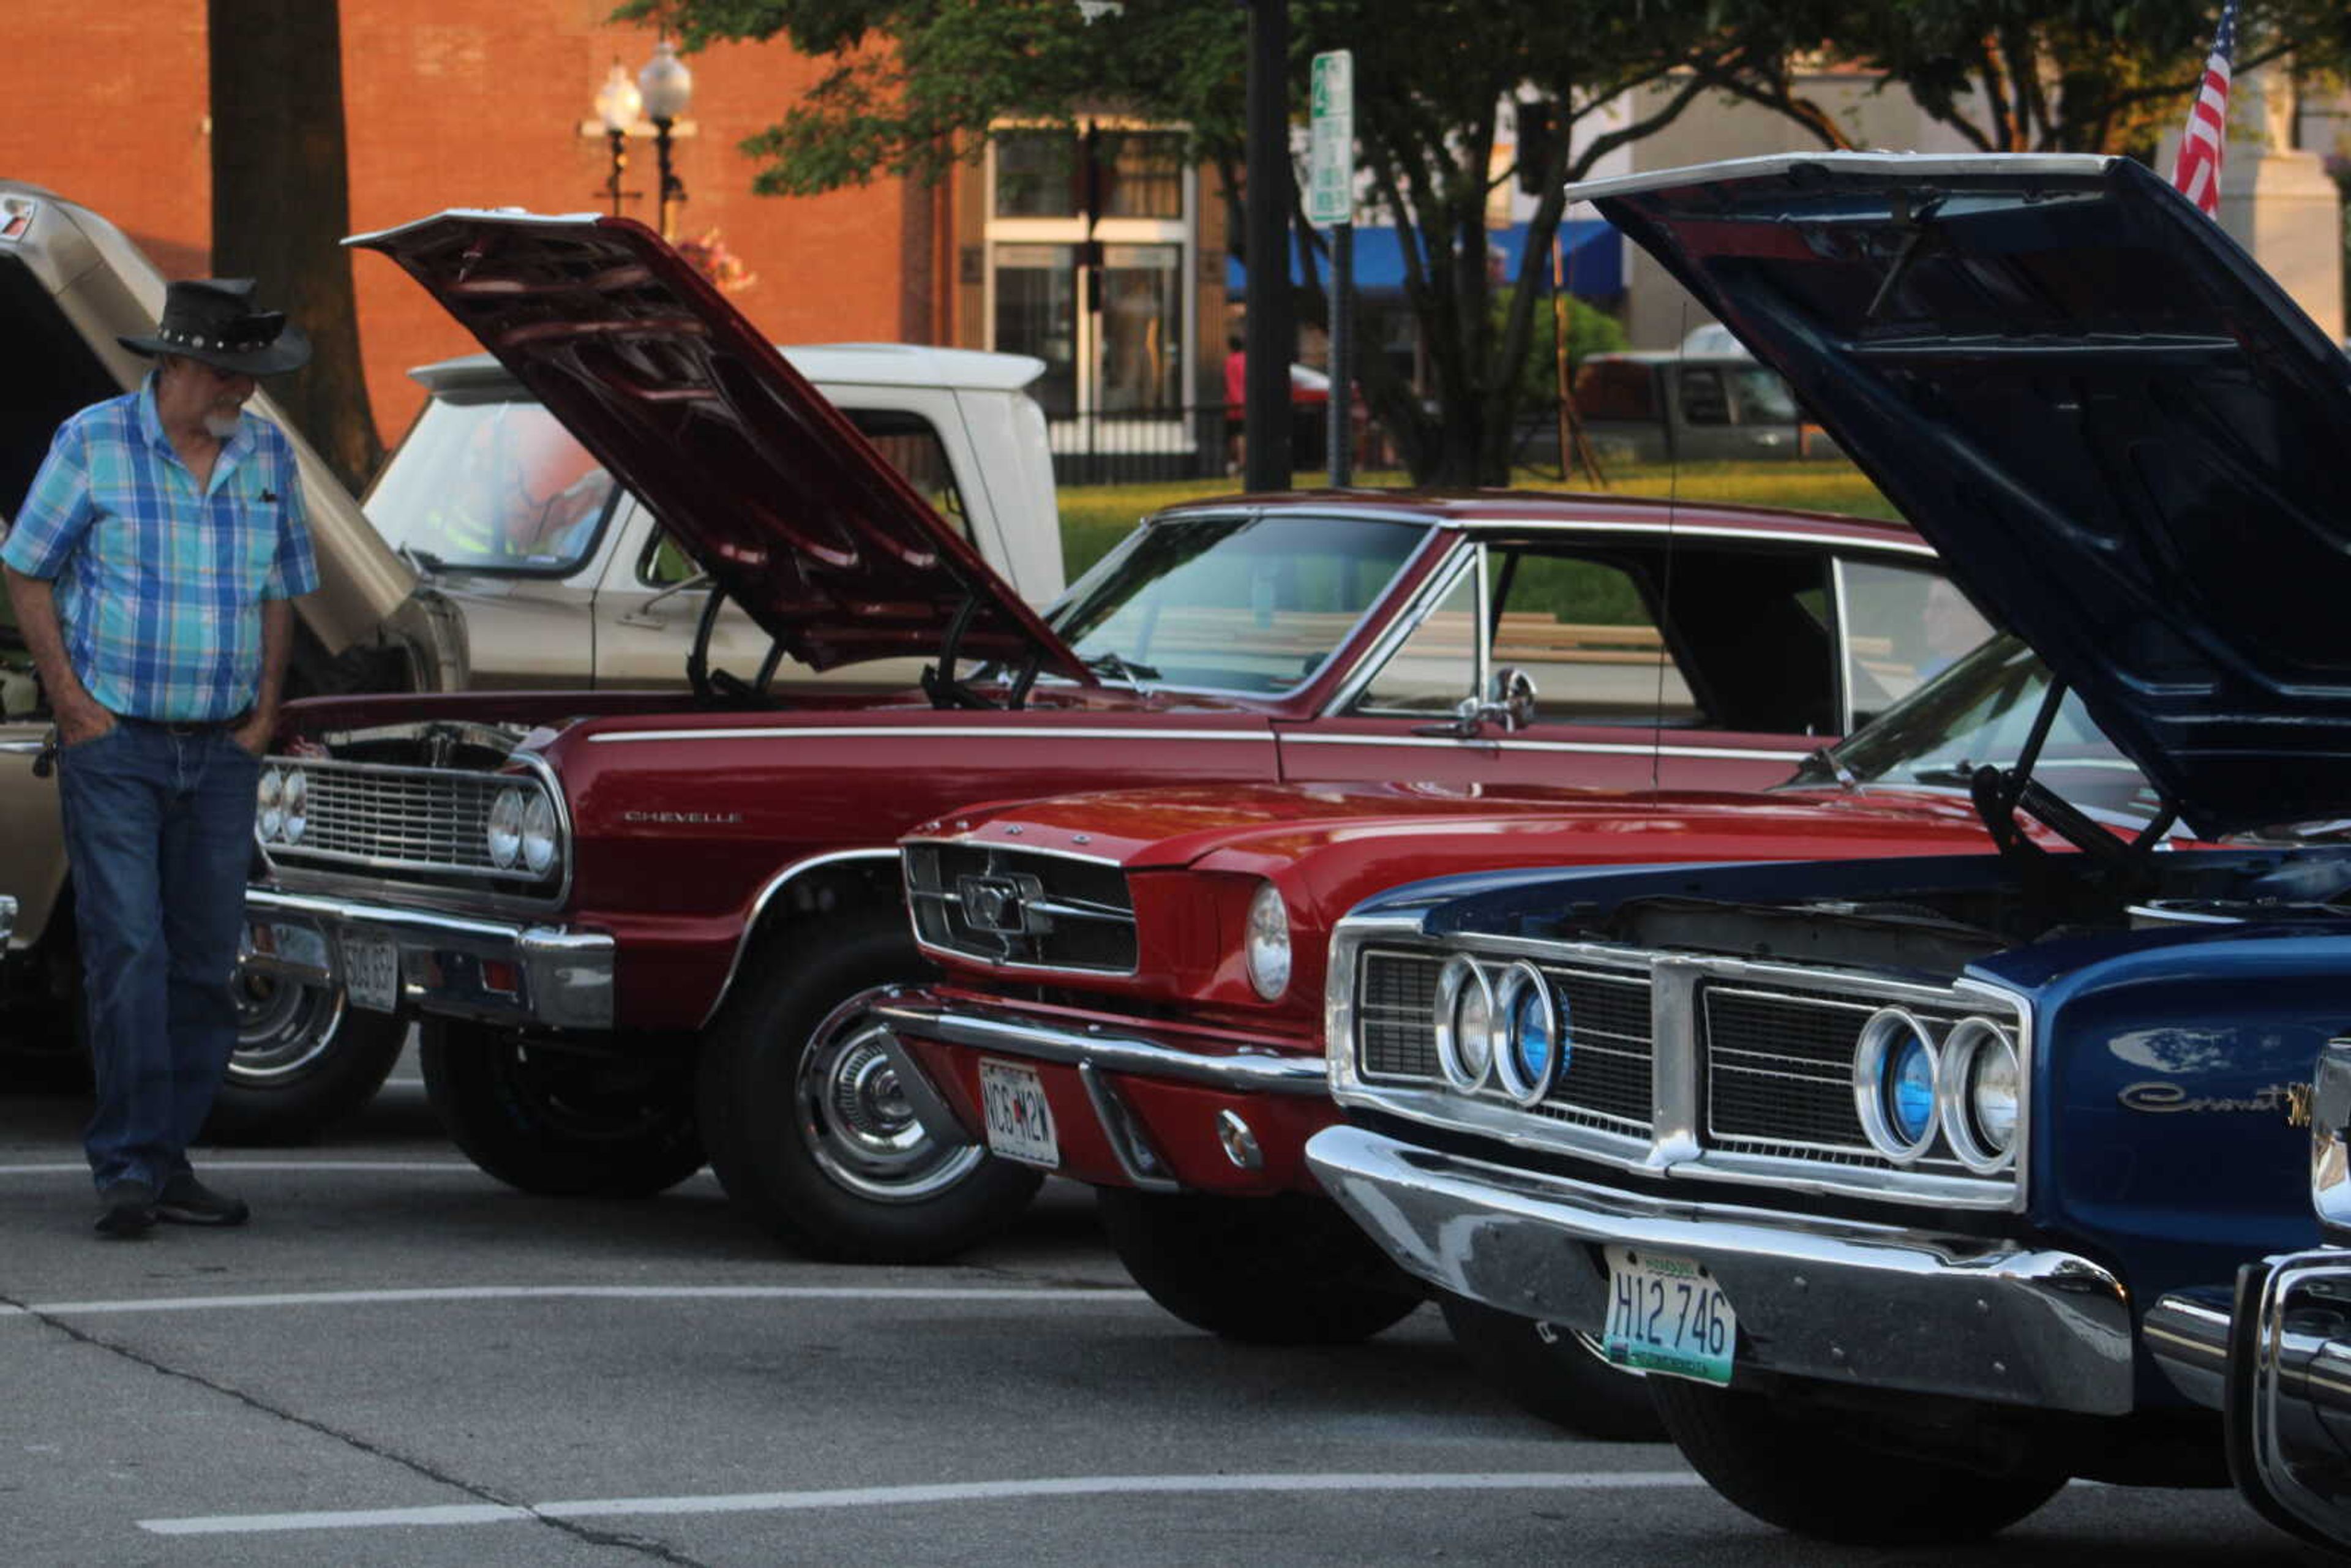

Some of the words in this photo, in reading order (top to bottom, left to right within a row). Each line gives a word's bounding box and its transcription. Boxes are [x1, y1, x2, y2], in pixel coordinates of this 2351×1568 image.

[624, 811, 742, 823] CHEVELLE
[2117, 1081, 2282, 1112] Coronet
[1613, 1272, 1664, 1345] H12
[1674, 1284, 1725, 1355] 746
